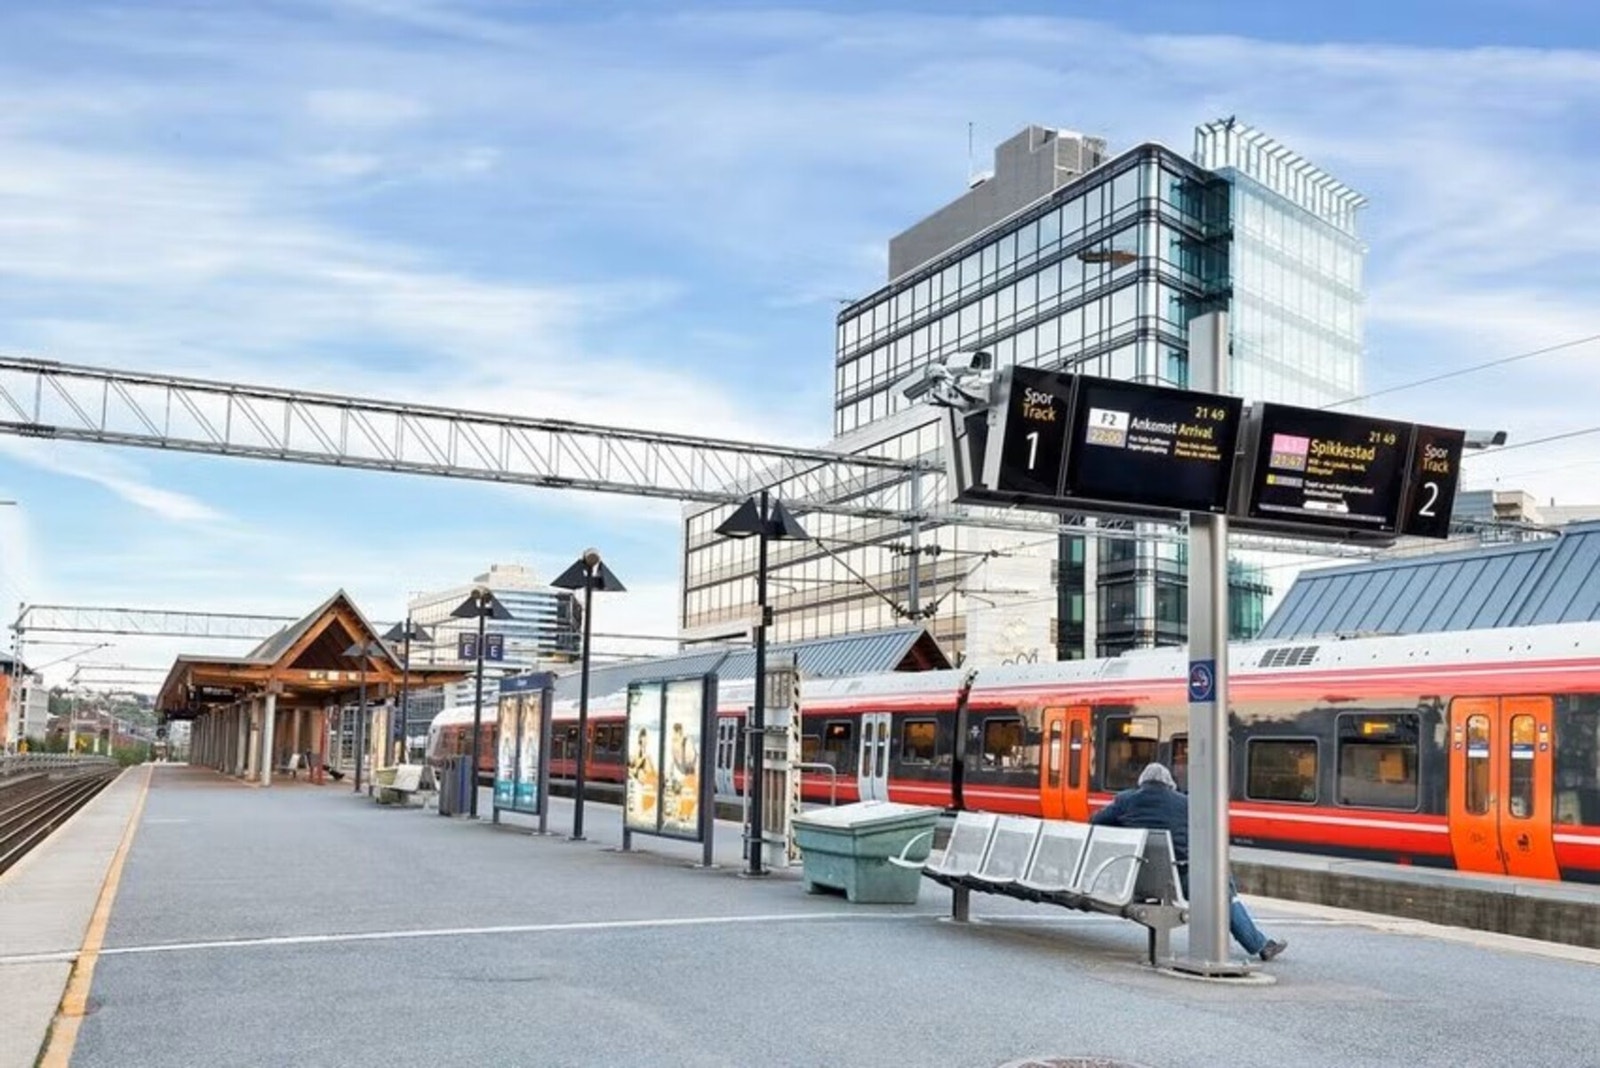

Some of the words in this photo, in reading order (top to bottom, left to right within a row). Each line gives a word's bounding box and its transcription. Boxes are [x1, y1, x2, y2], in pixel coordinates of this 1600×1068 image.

[1024, 387, 1053, 406] Spor
[1022, 403, 1056, 421] Track
[1131, 417, 1177, 434] Ankomst
[1177, 423, 1214, 440] Arrival
[1026, 431, 1040, 470] 1
[1310, 439, 1375, 460] Spikkestad
[1424, 443, 1448, 459] Spor
[1422, 457, 1449, 473] Track
[1418, 482, 1439, 516] 2
[491, 646, 498, 657] E
